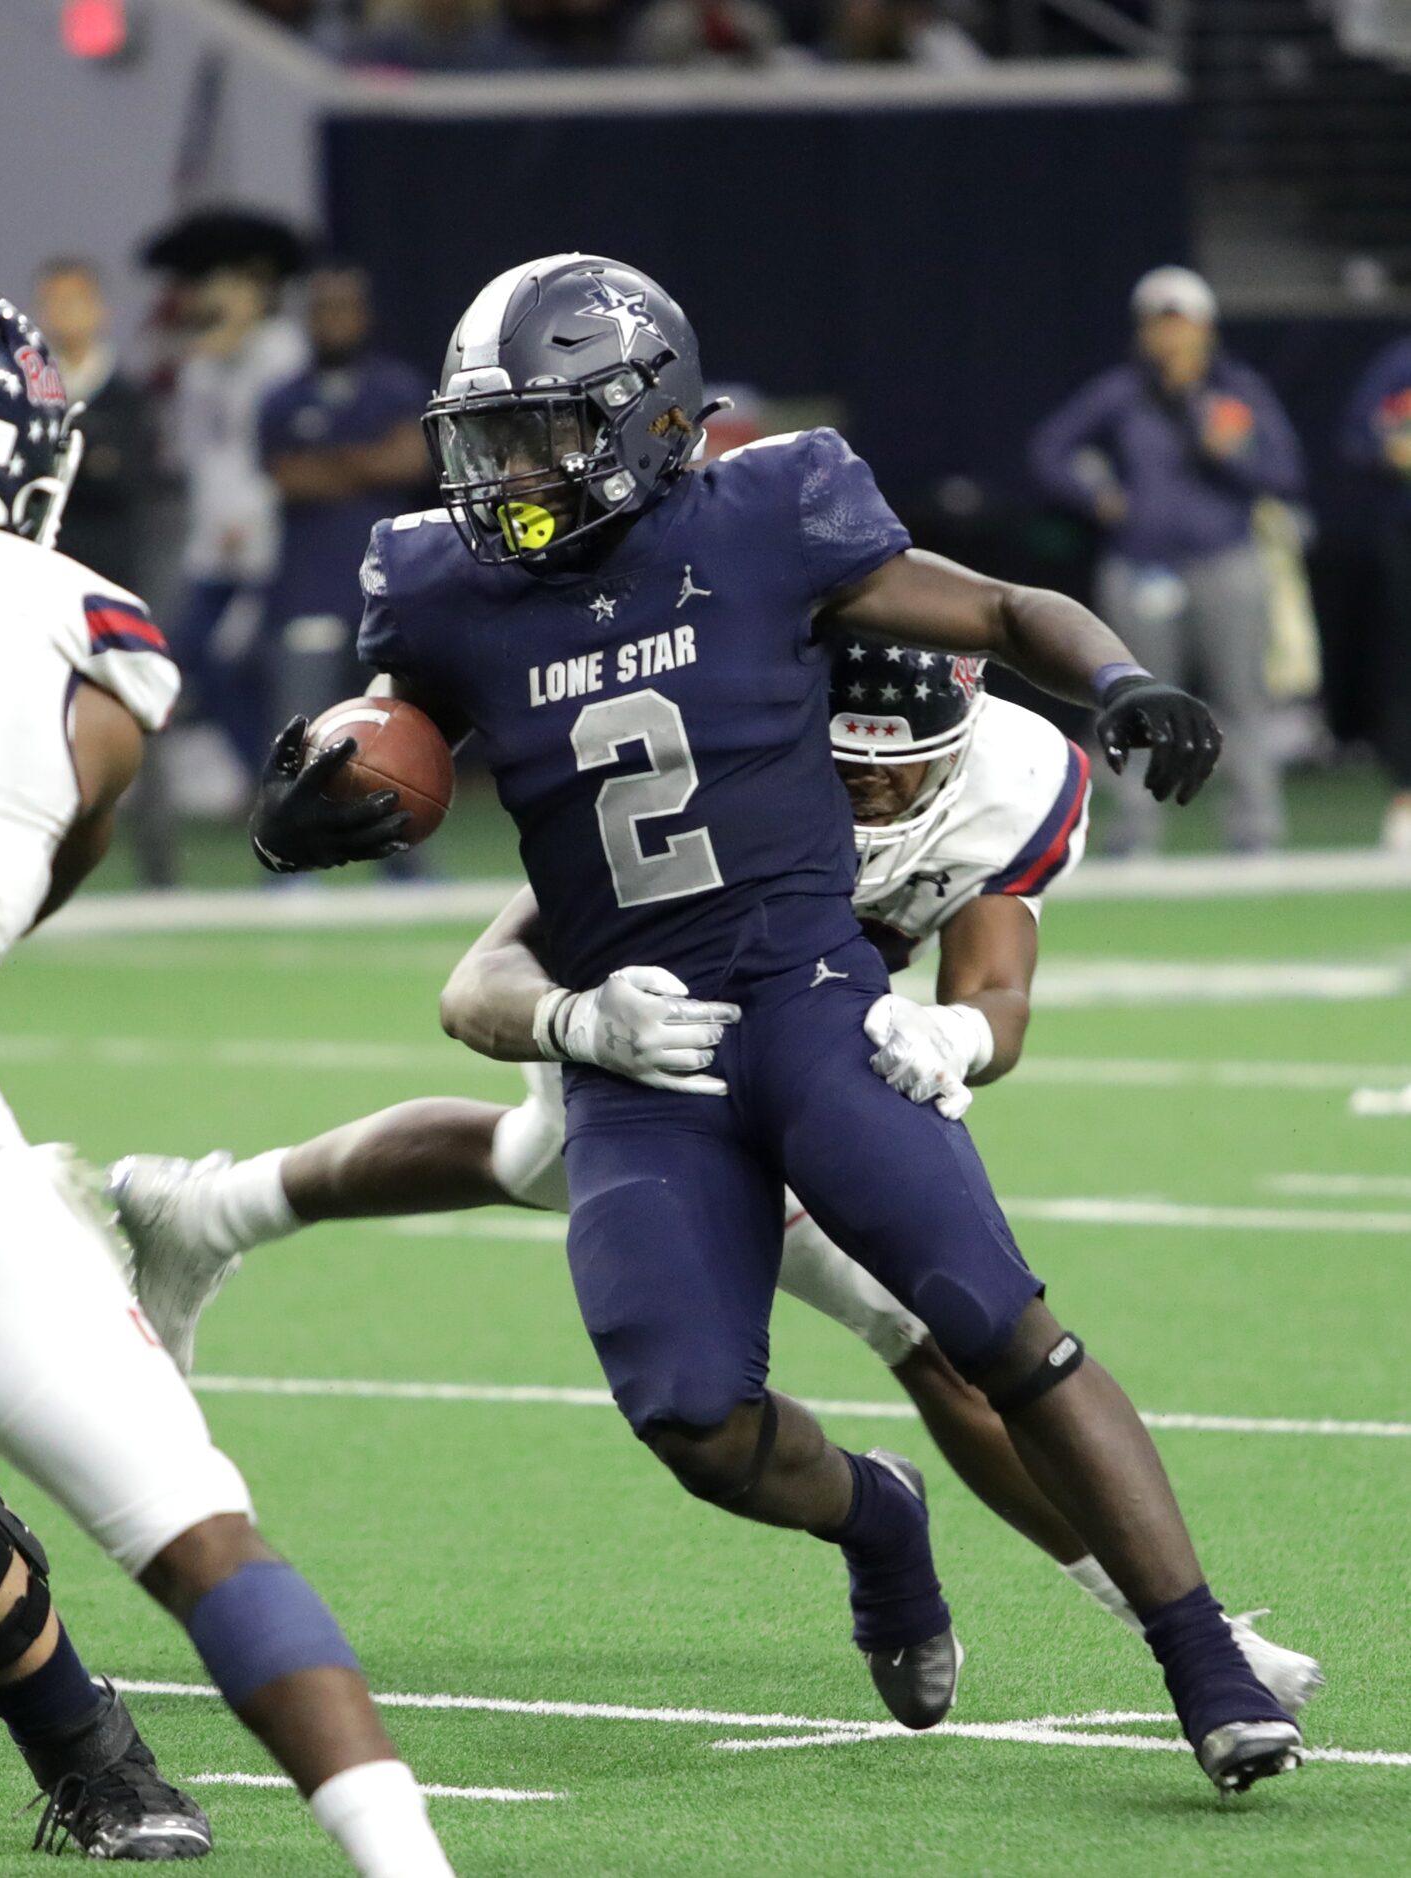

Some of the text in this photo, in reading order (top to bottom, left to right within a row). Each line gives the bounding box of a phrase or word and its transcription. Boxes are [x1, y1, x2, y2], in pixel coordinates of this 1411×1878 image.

[528, 623, 697, 708] LONE STAR
[569, 687, 725, 909] 2
